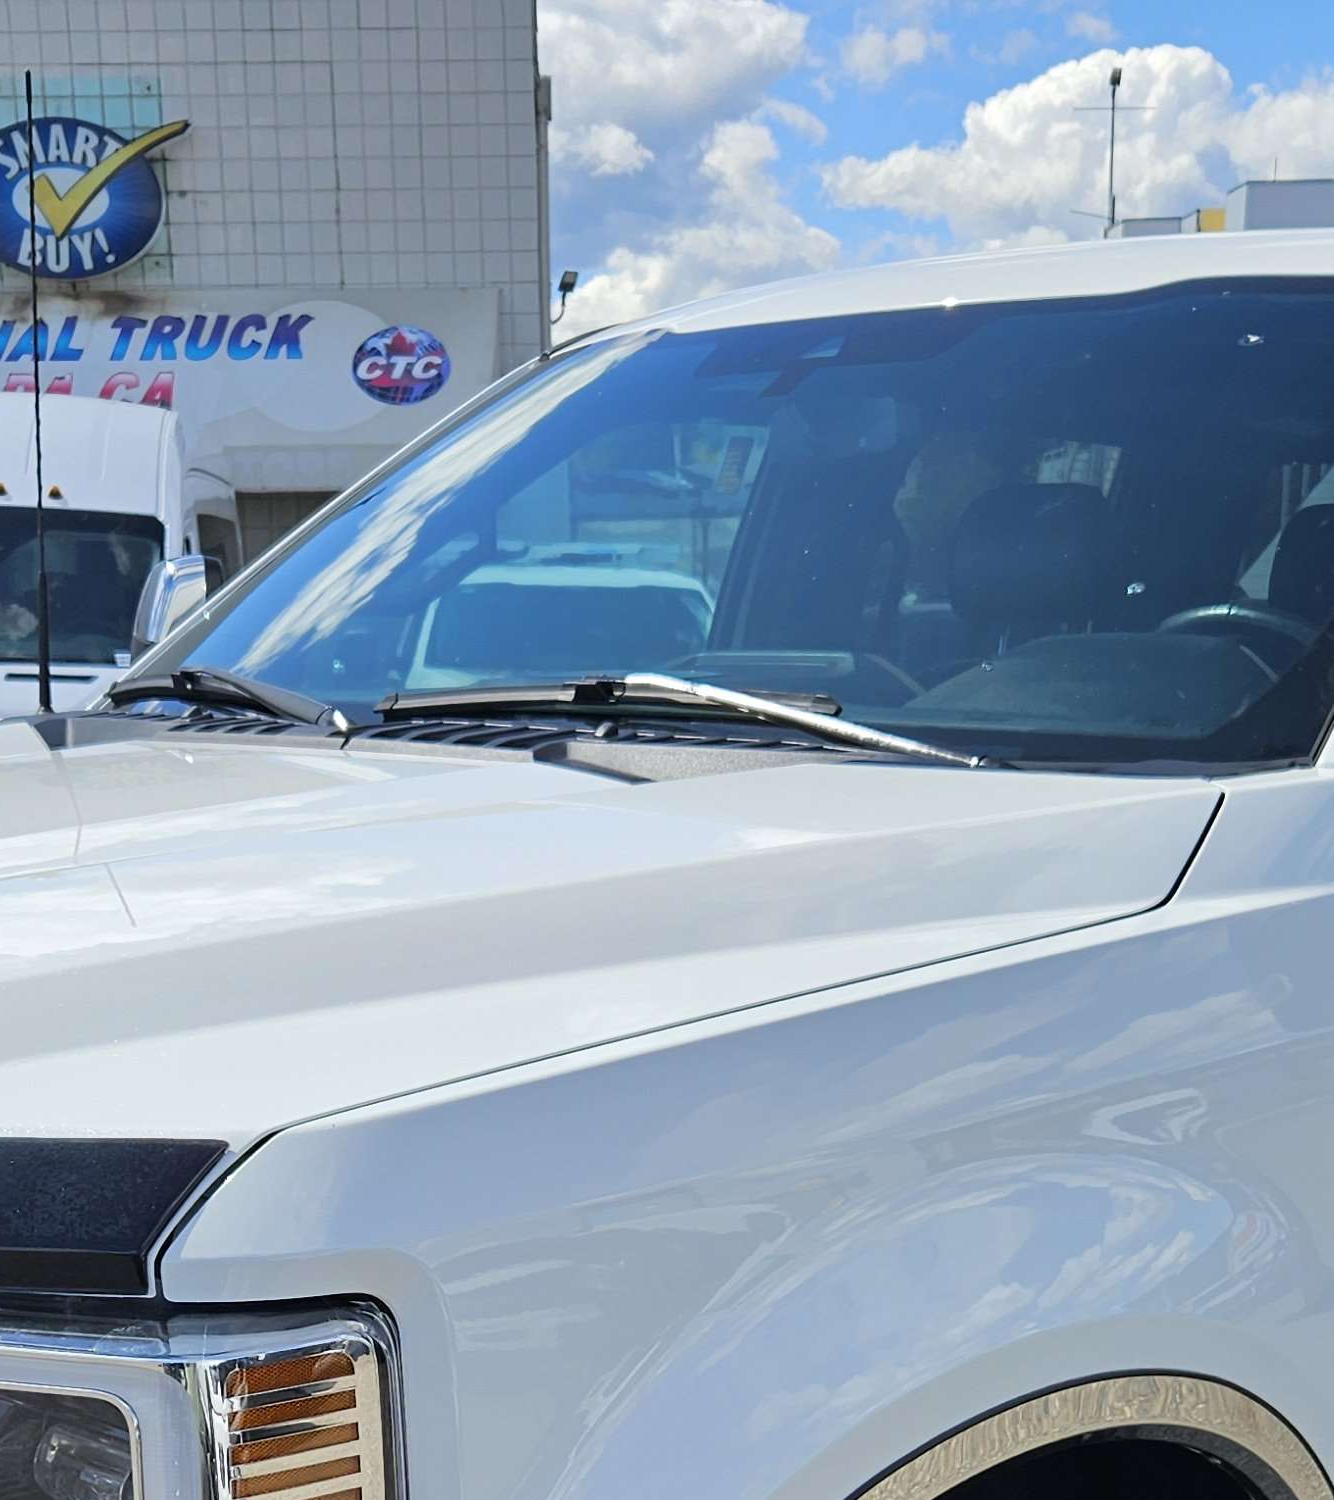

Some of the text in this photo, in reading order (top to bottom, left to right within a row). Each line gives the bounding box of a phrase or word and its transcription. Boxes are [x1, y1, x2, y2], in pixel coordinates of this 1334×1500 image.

[17, 227, 116, 273] BUY!
[109, 313, 315, 362] TRUCK
[356, 355, 443, 380] CTC
